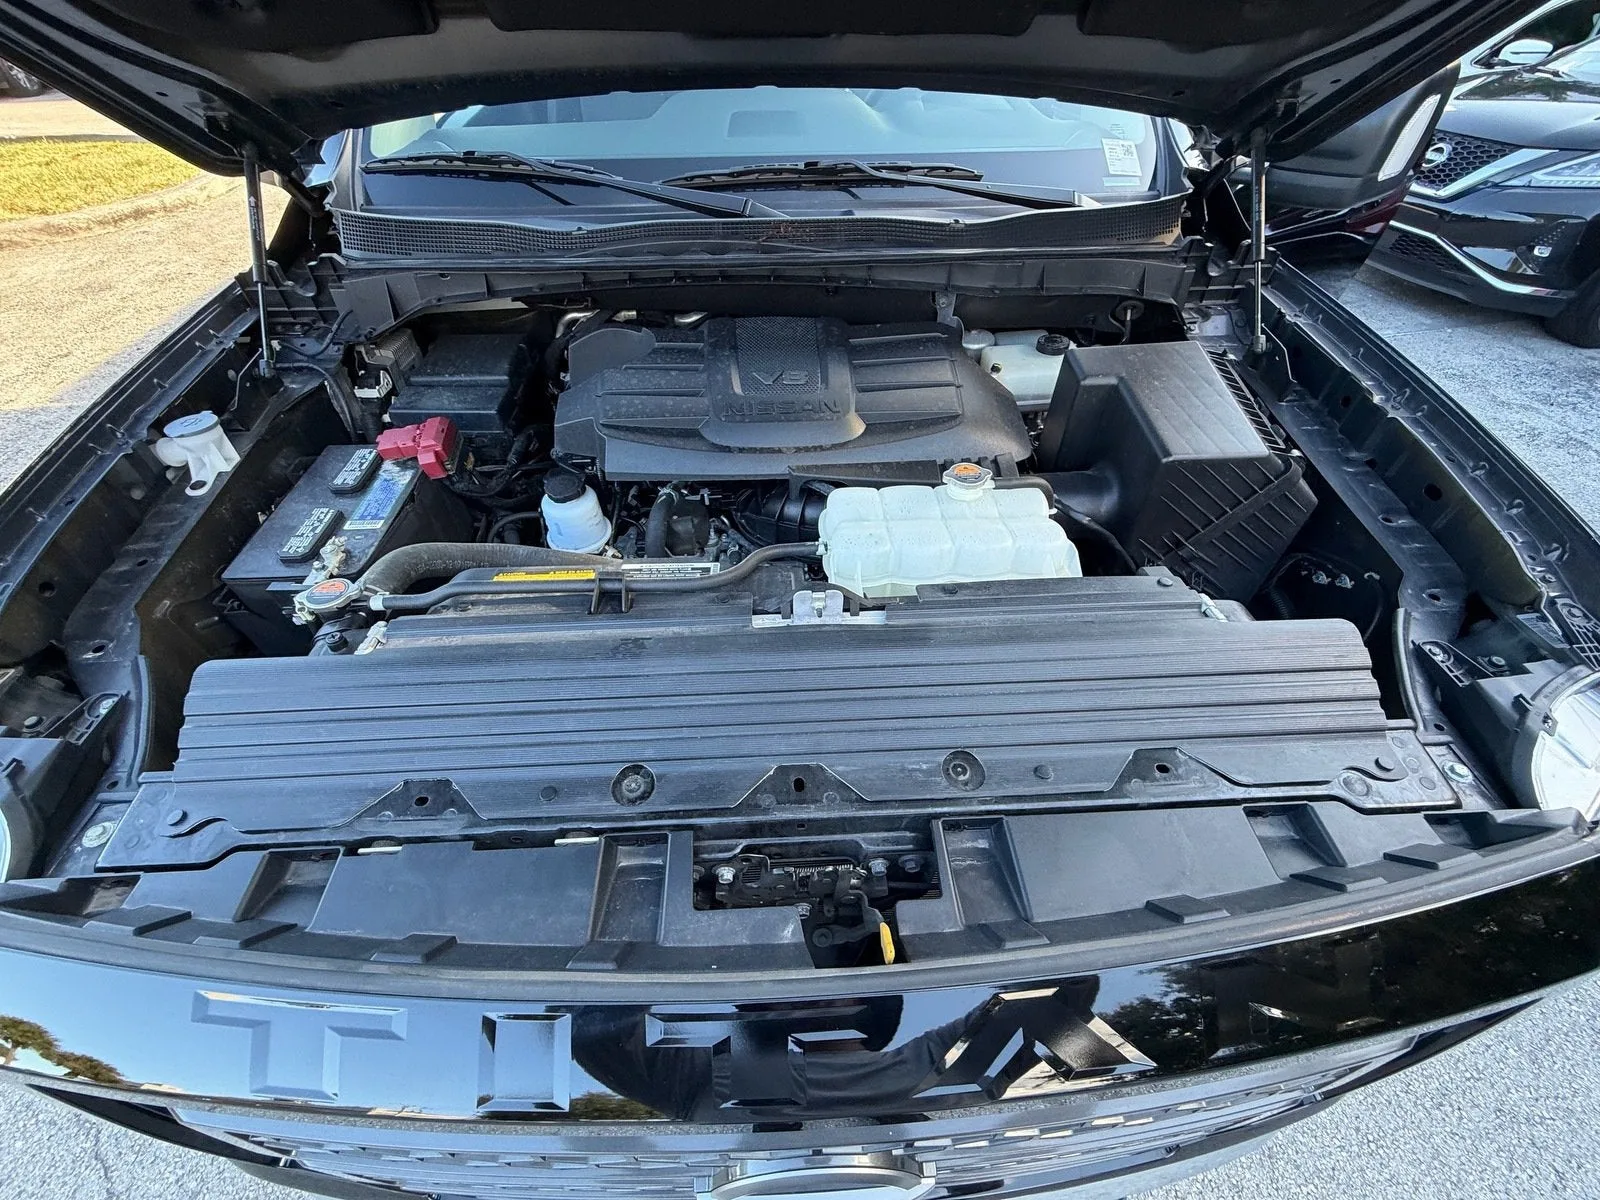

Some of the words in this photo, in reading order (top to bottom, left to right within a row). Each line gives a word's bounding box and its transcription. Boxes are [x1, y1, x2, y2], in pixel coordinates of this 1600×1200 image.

[752, 369, 809, 386] V8
[724, 399, 840, 415] NISSAN
[190, 948, 1378, 1114] TITAN
